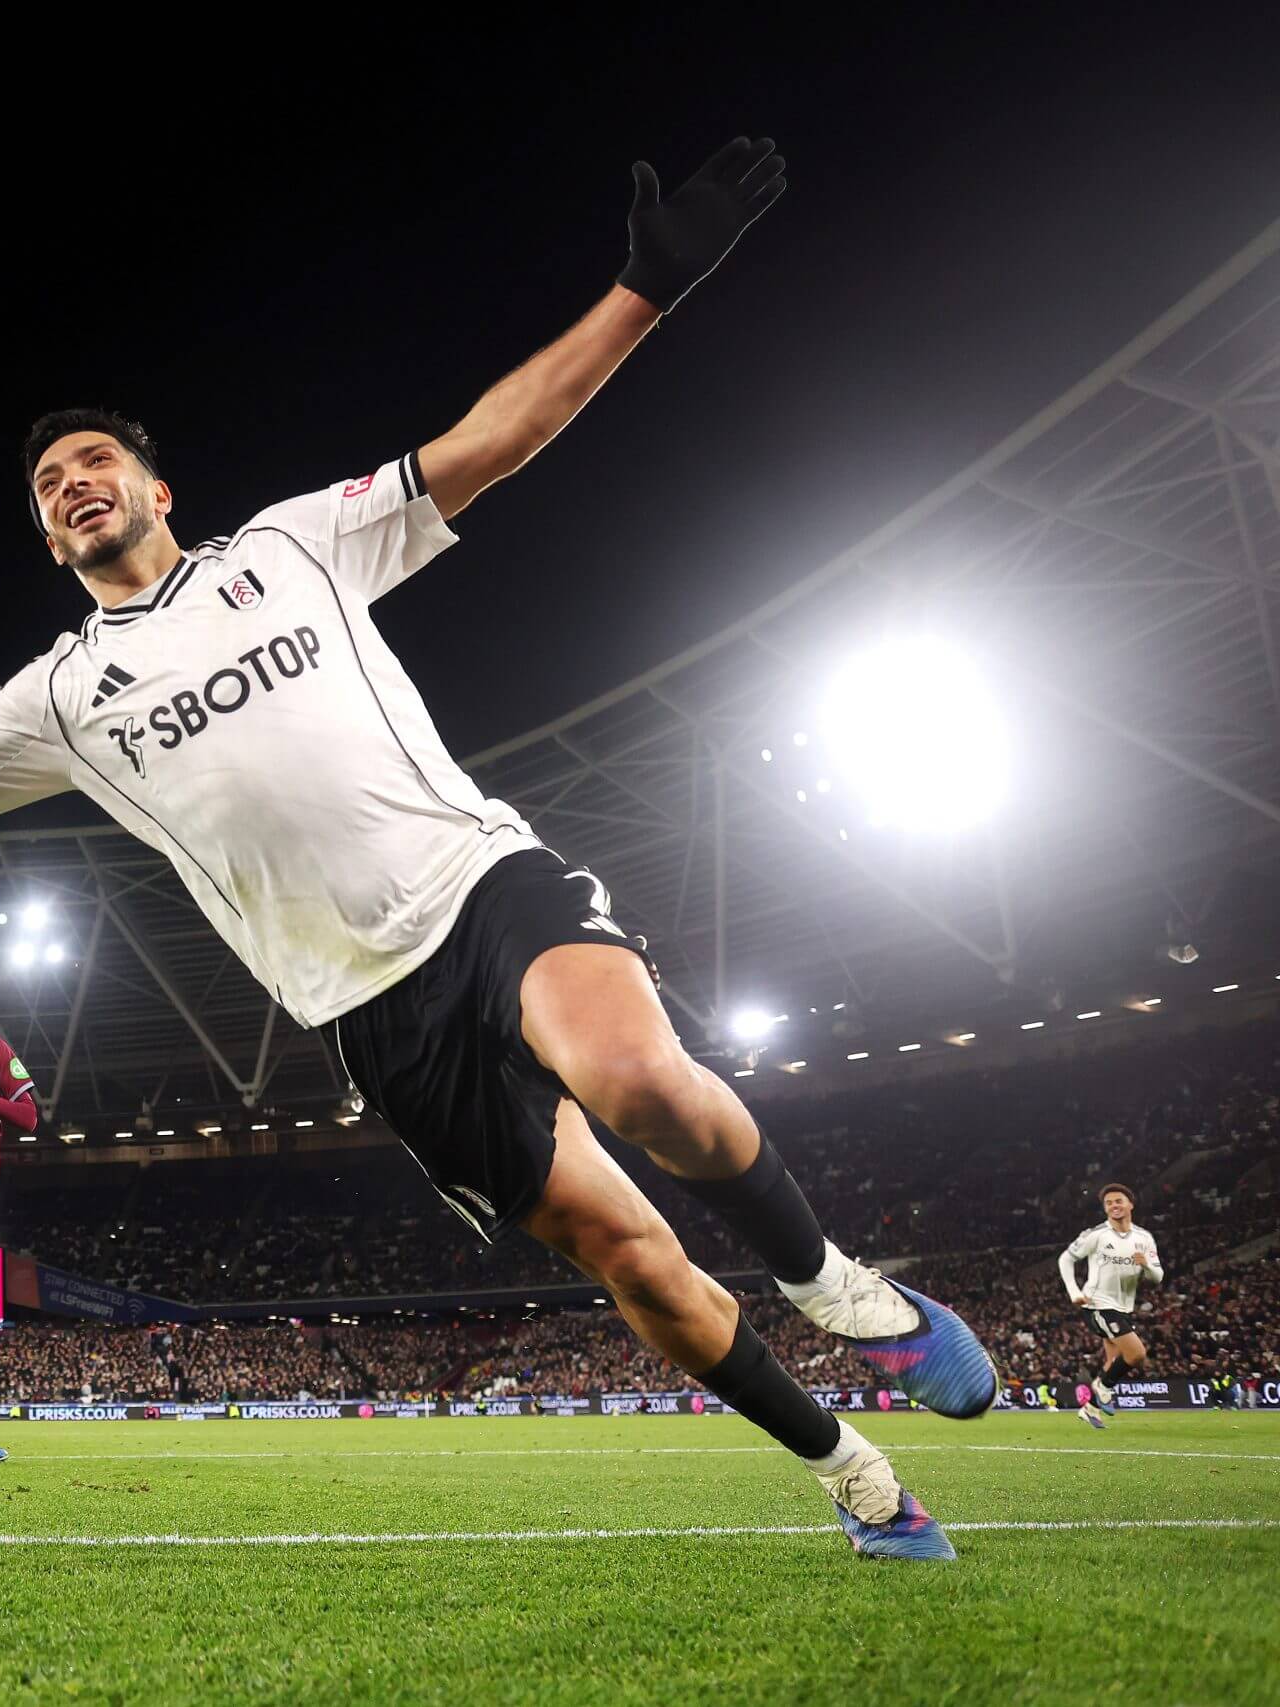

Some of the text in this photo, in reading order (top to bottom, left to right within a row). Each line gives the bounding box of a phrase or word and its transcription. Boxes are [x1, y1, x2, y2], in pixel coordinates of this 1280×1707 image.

[231, 580, 256, 606] FFC
[149, 626, 321, 750] SBOTOP
[1111, 1255, 1136, 1266] SBOT
[67, 1280, 125, 1306] CONNECTED
[1121, 1383, 1169, 1395] PLUMMER
[1118, 1397, 1145, 1408] RISKS
[28, 1407, 128, 1421] LPRISKS.CO.UK
[242, 1406, 342, 1419] LPRISKS.CO.UK
